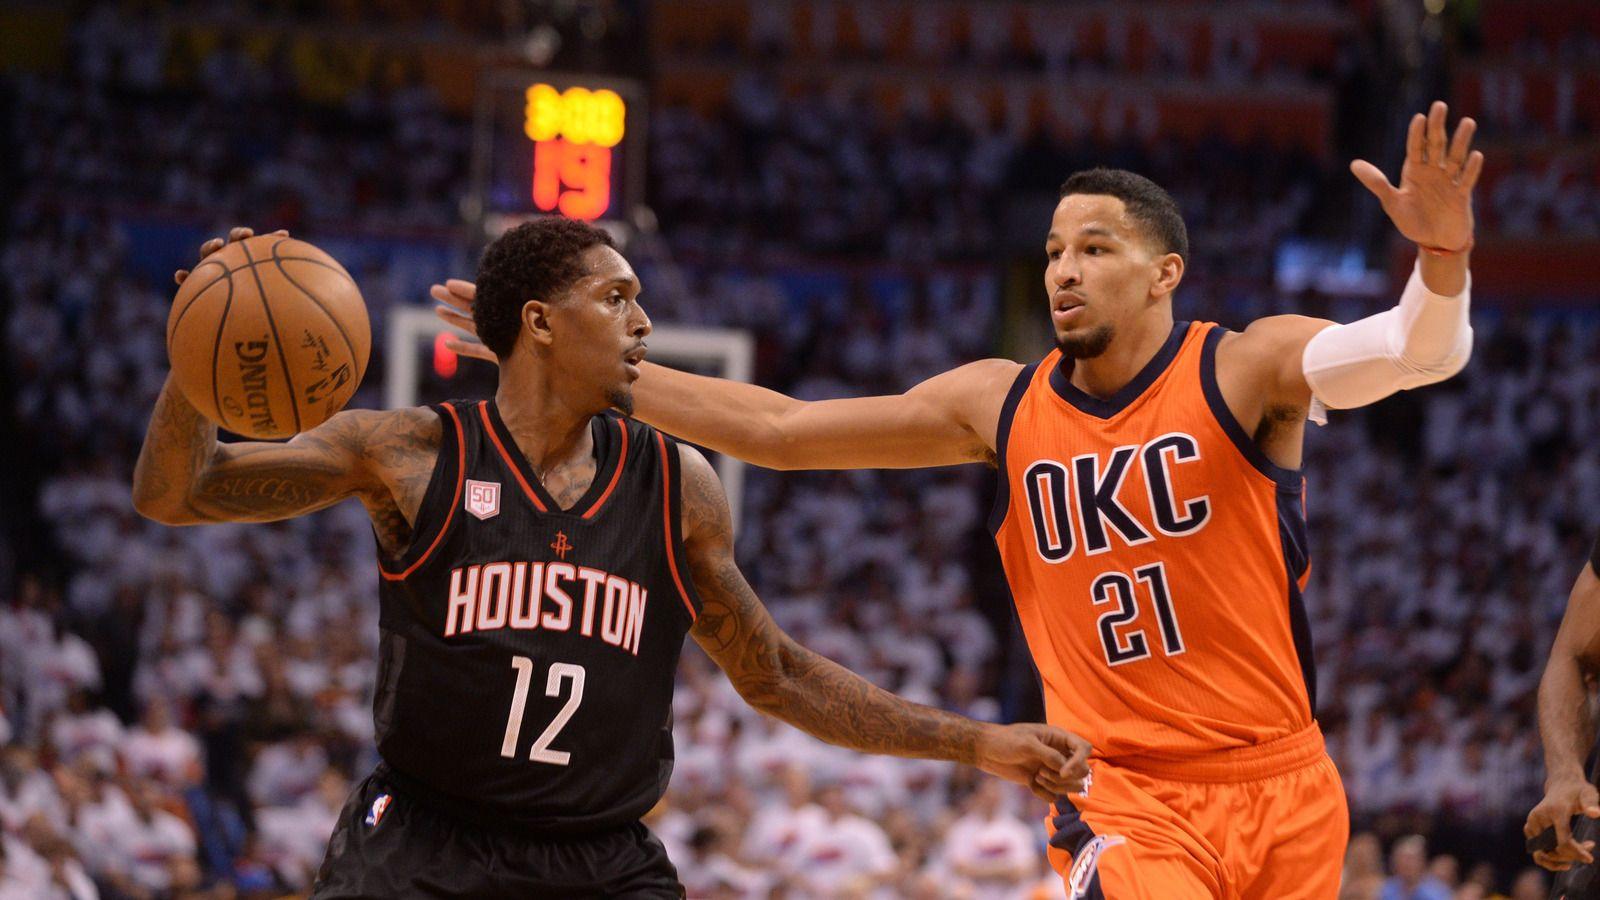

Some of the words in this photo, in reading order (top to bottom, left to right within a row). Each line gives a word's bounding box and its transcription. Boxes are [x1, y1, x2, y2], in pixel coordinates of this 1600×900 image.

[532, 139, 611, 222] 19
[472, 486, 493, 503] 50
[1023, 432, 1212, 564] OKC
[444, 561, 648, 656] HOUSTON
[1090, 561, 1186, 666] 21
[501, 656, 586, 766] 12
